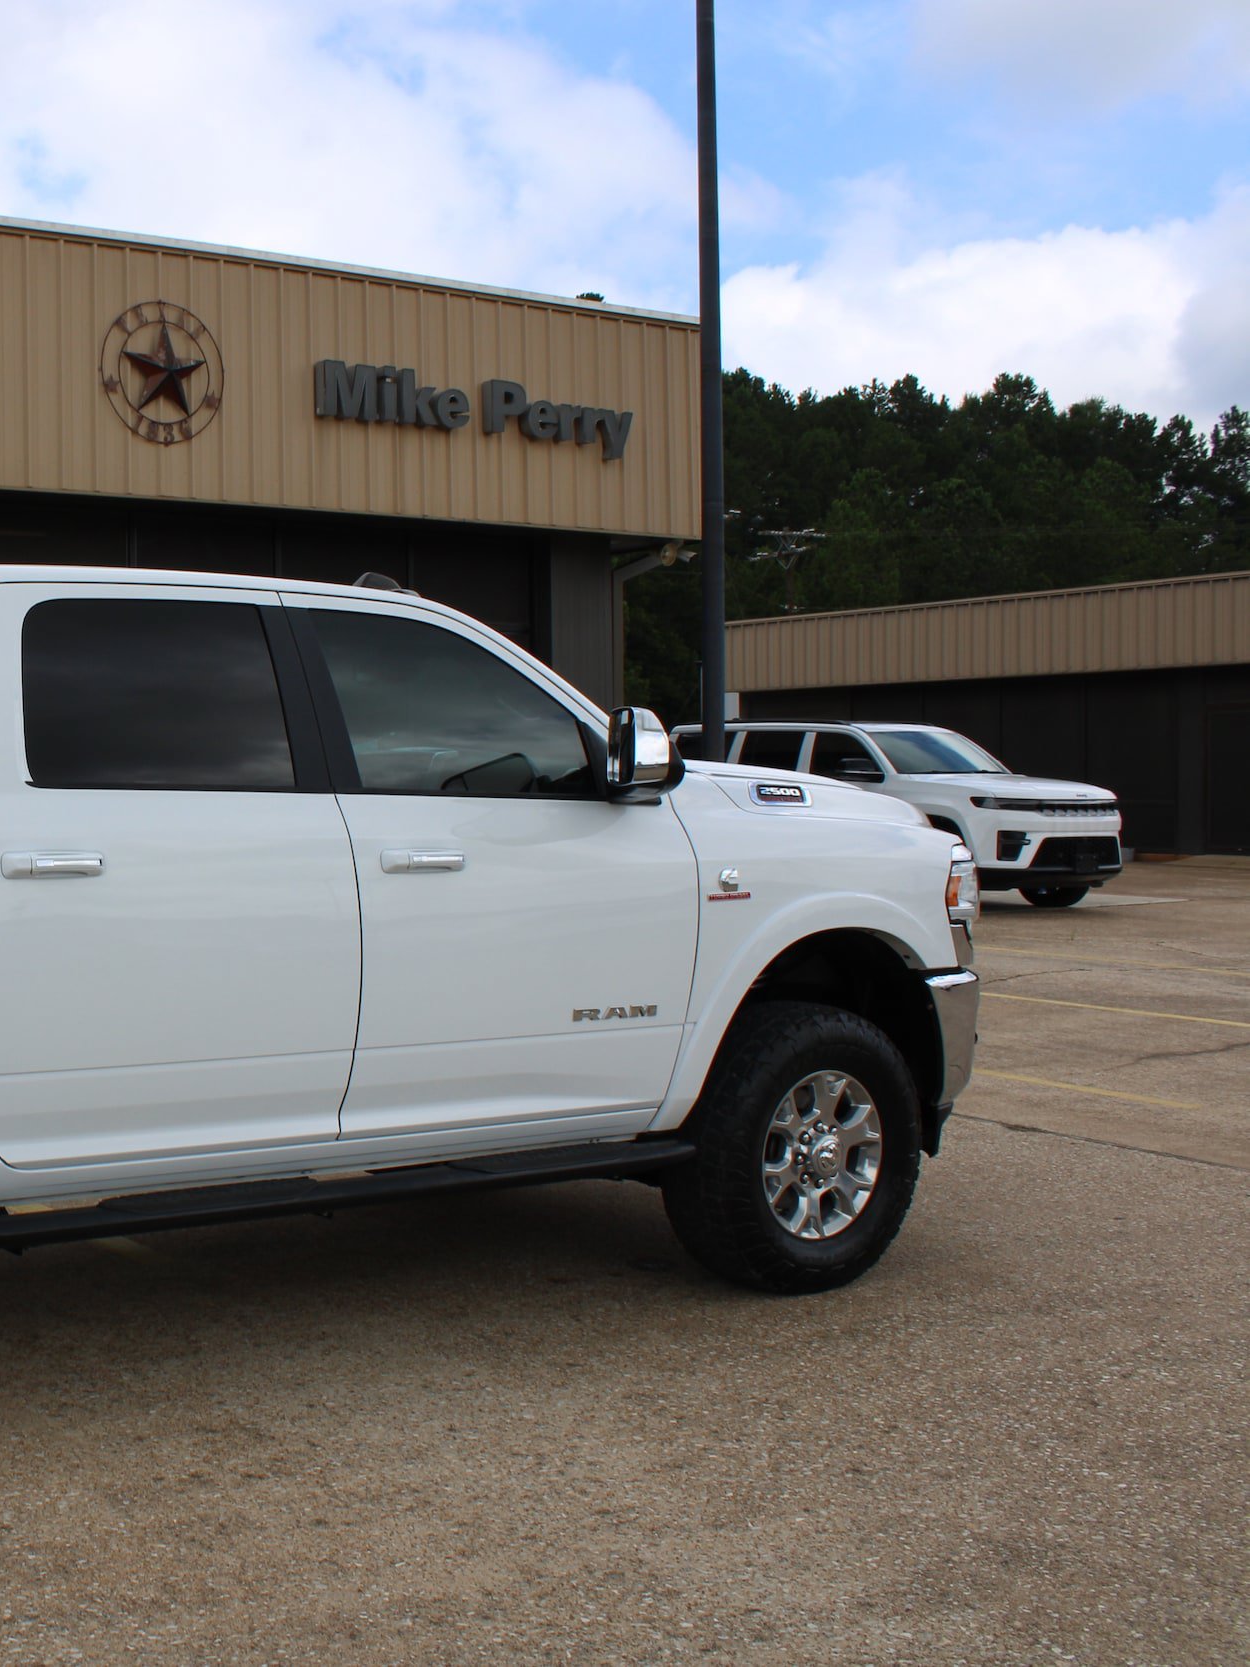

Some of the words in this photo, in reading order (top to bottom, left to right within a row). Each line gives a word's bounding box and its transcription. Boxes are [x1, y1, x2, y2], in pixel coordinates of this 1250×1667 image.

[313, 359, 470, 431] Mike
[481, 378, 634, 462] Perry
[759, 786, 801, 798] 2500
[572, 1003, 658, 1022] RAM
